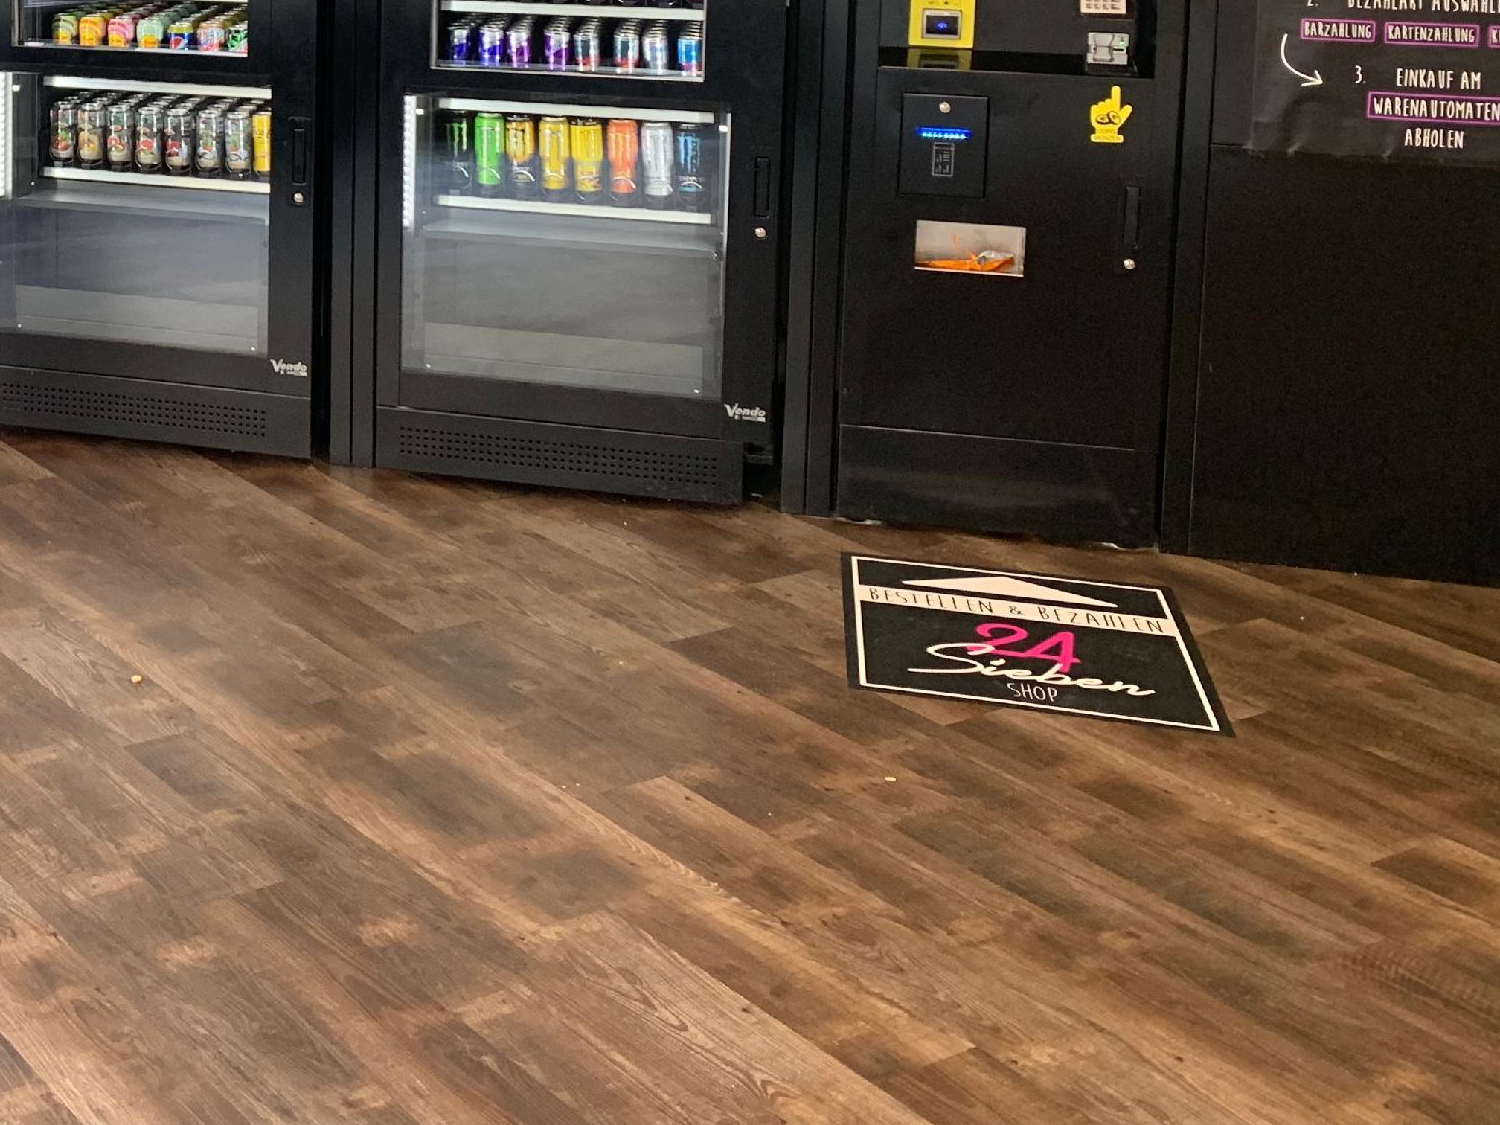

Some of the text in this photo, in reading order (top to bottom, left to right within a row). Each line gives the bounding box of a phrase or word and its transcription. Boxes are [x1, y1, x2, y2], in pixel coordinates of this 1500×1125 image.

[1304, 21, 1372, 39] BARZAHLUNG
[1388, 24, 1476, 43] KARTENZAHLUNG
[1355, 65, 1482, 90] 3. EINKAUF AM
[1404, 128, 1465, 149] ABHOLEN
[869, 586, 1165, 635] BESTELLEN & BEZAHLEN
[966, 622, 1081, 674] 24
[907, 642, 1156, 697] Sieben
[1006, 682, 1058, 703] SHOP
